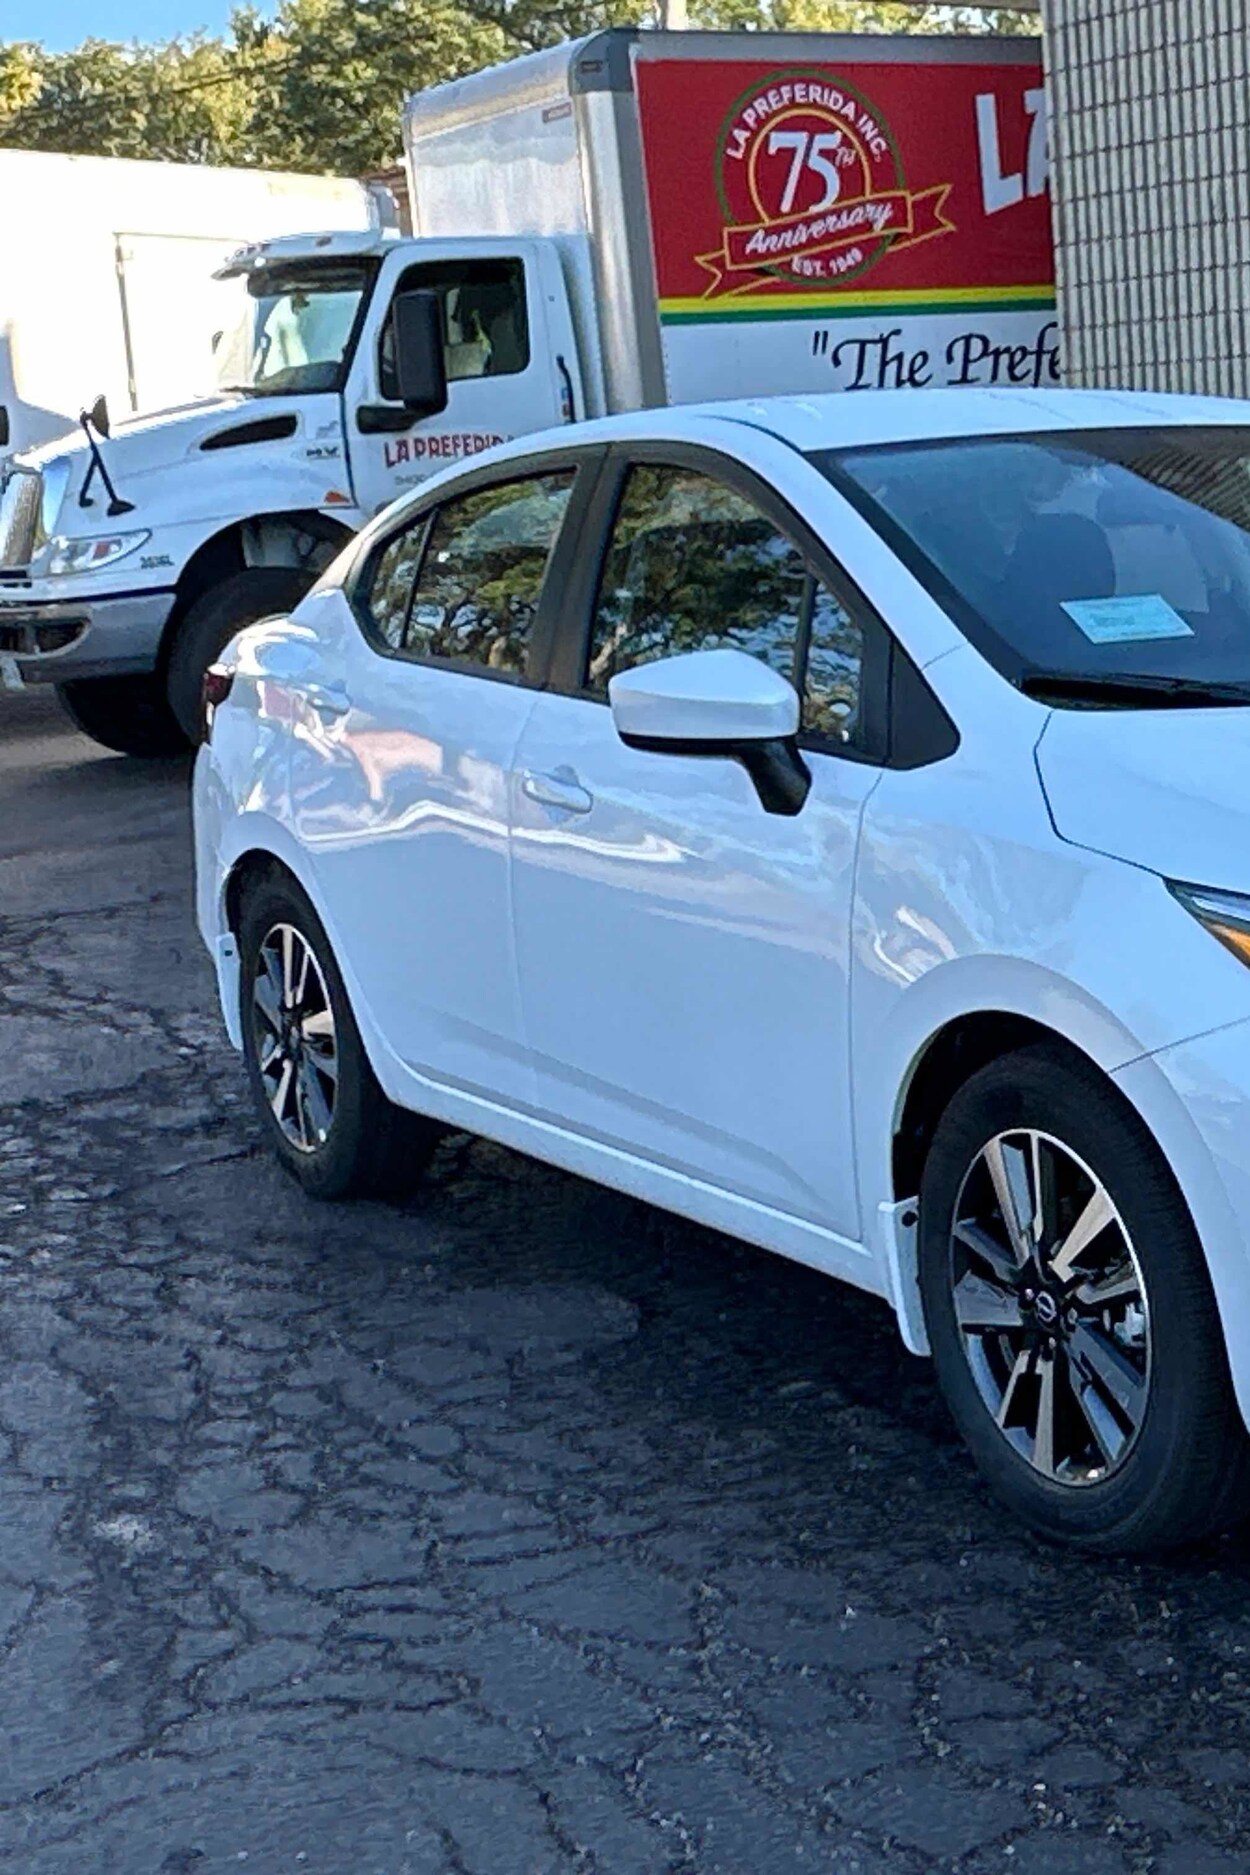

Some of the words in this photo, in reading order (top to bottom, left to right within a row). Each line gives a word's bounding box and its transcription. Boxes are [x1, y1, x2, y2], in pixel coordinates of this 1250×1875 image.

[726, 128, 750, 159] LA
[742, 83, 856, 129] PREFERIDA
[745, 202, 893, 254] Anniversary
[384, 438, 410, 468] LA
[413, 432, 514, 459] PREFERID
